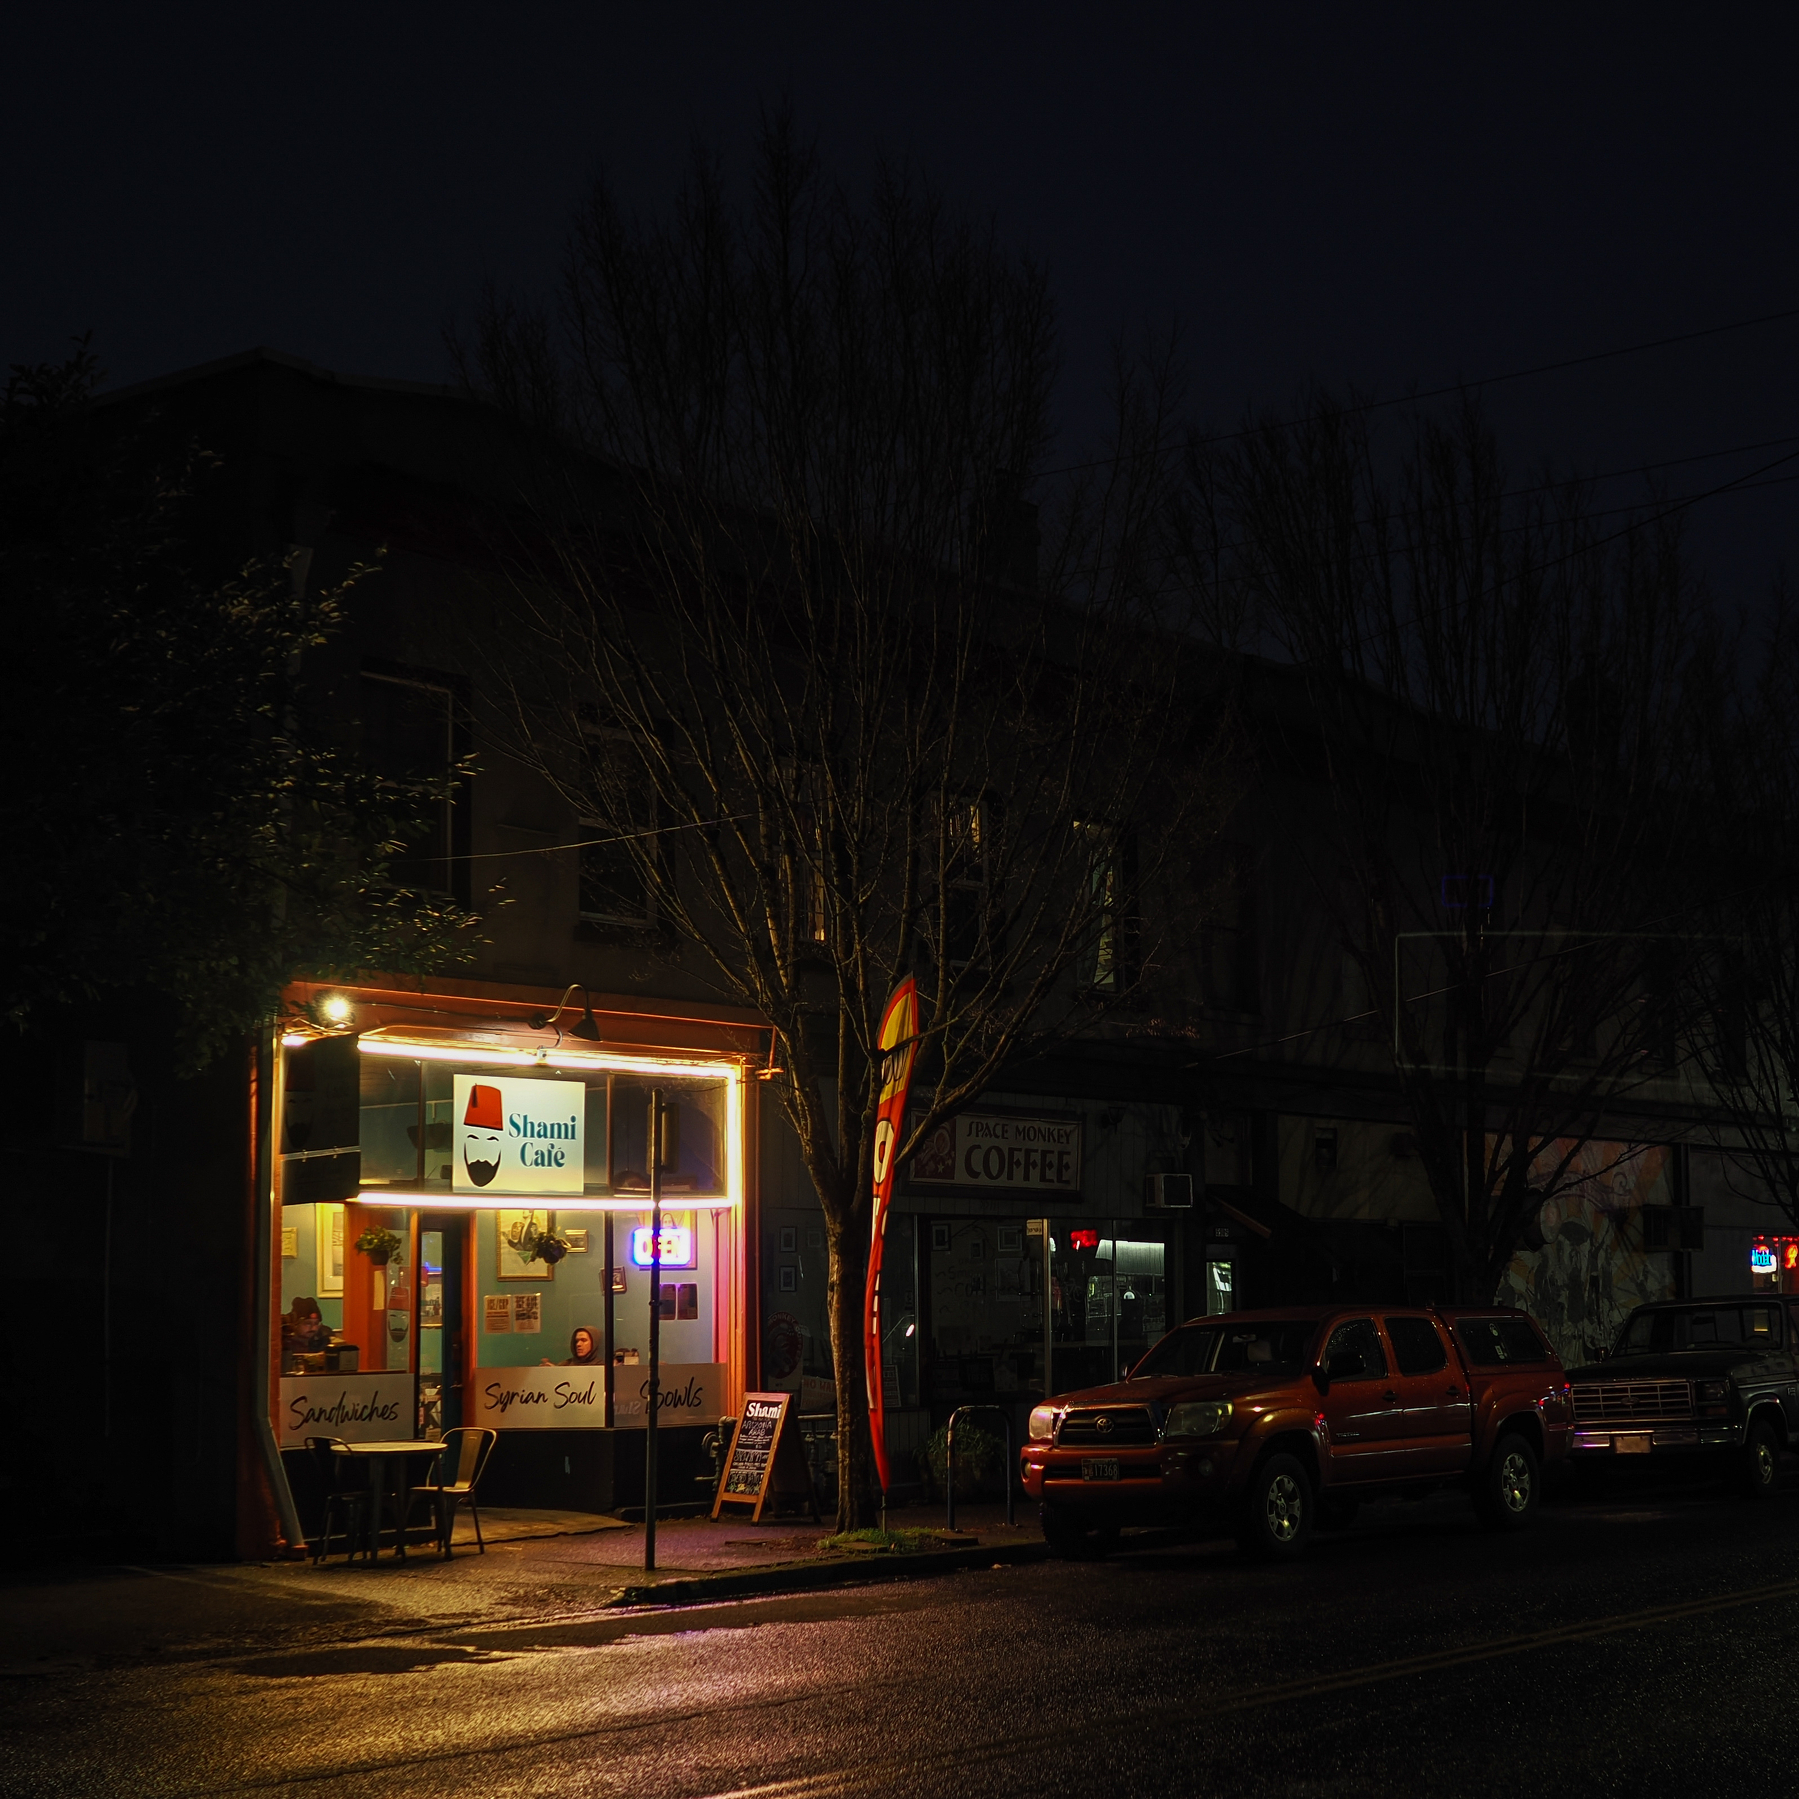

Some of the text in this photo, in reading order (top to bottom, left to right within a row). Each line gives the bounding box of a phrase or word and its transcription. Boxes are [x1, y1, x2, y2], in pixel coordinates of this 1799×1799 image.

[508, 1112, 577, 1140] Shami
[966, 1121, 1073, 1145] SPACE MONKEY
[520, 1141, 566, 1168] Café
[964, 1144, 1071, 1185] COFFEE
[289, 1390, 400, 1431] Sandwiches
[484, 1382, 548, 1413] Syrian
[553, 1380, 597, 1409] Soul
[746, 1402, 783, 1419] Shami
